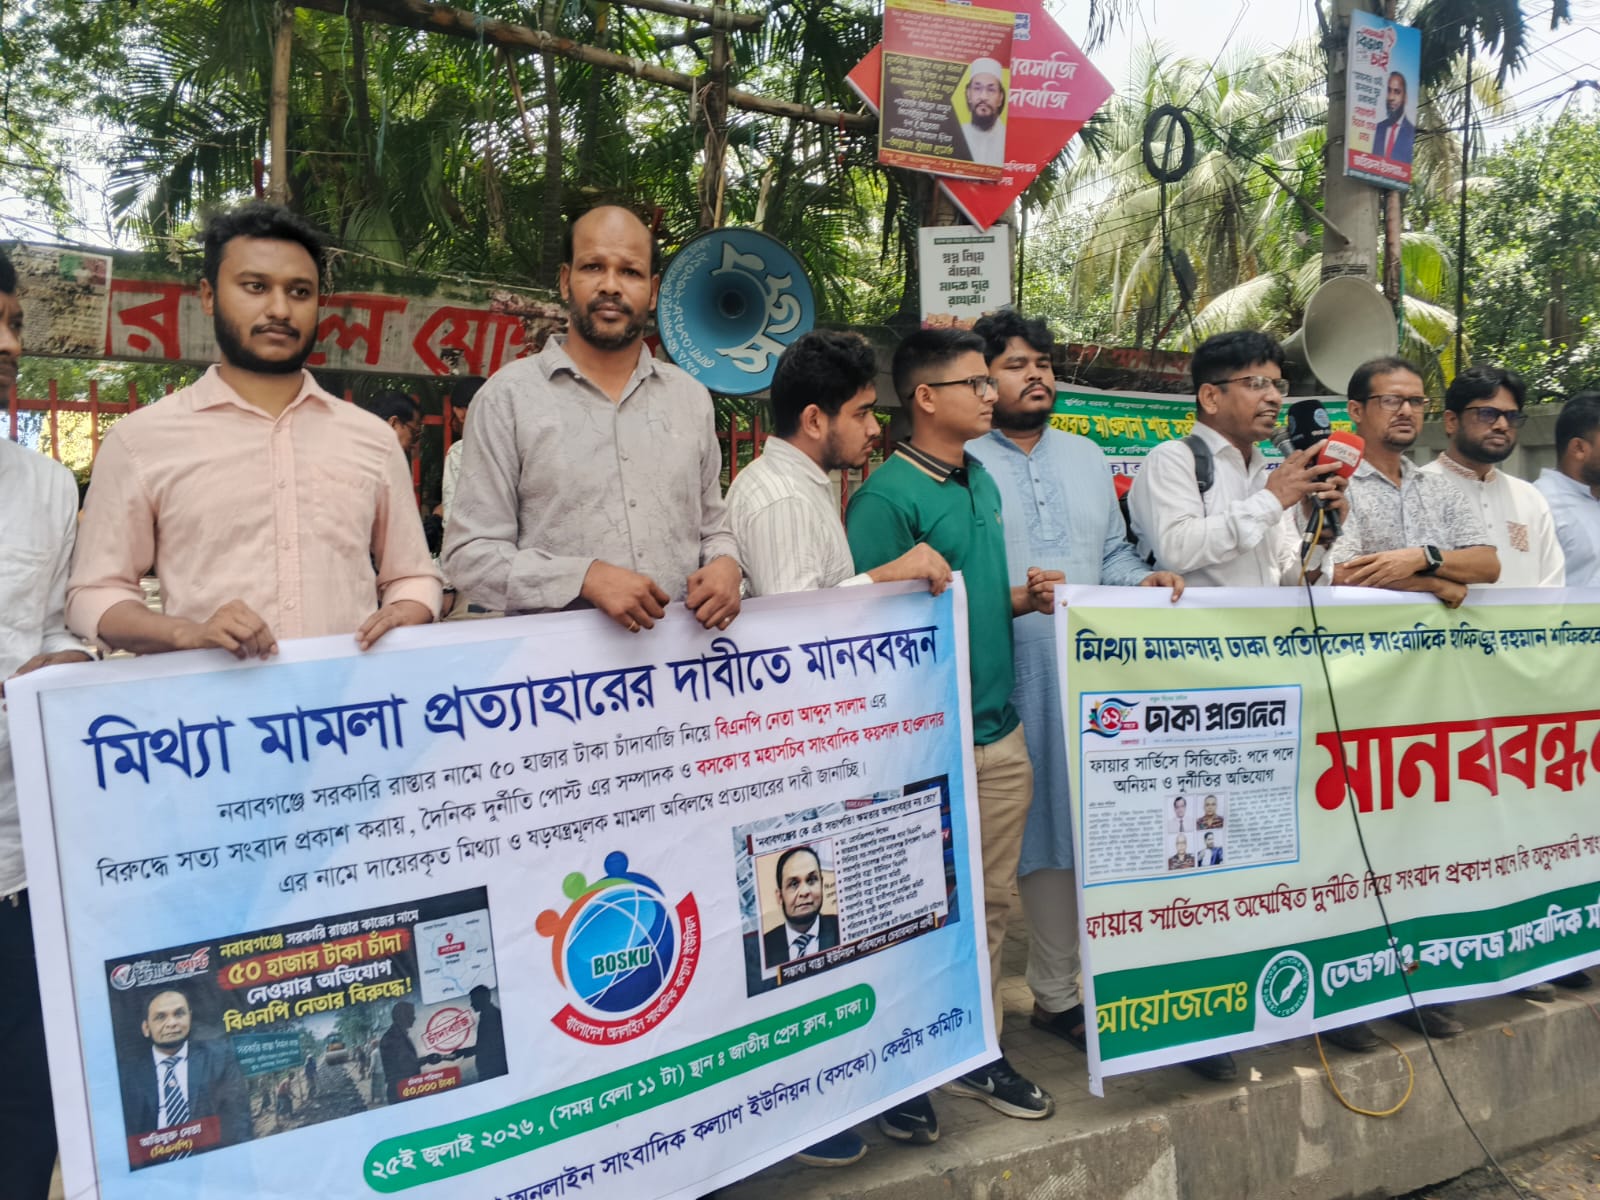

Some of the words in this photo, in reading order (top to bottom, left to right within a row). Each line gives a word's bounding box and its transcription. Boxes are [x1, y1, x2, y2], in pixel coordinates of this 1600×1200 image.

[1010, 51, 1079, 82] ারসাজি
[1007, 81, 1070, 110] দাবাজি
[1075, 628, 1137, 666] মিথ্যা
[1144, 637, 1222, 662] মামলায়
[1225, 636, 1268, 658] ঢাকা
[1273, 626, 1365, 656] প্রতিদিনের
[1369, 622, 1446, 653] সাংবাদিক
[1498, 629, 1546, 650] রহমান
[82, 713, 235, 791] মিথ্যা
[249, 693, 407, 763] মামলা
[425, 664, 657, 740] প্রত্যাহারের
[666, 637, 792, 702] দাবীতে
[799, 625, 939, 682] মানববন্ধন
[1145, 704, 1200, 733] ঢাকা
[1205, 700, 1287, 732] প্রতিদিন
[217, 792, 304, 823] নবাবগঞ্জে
[312, 774, 380, 807] সরকারি
[388, 770, 435, 796] রাস্তার
[442, 762, 482, 787] নামে
[490, 761, 515, 779] ৫০
[521, 748, 568, 773] হাজার
[575, 741, 608, 762] টাকা
[614, 725, 675, 757] চাঁদাবাজি
[680, 723, 711, 746] নিয়ে
[715, 711, 761, 740] বিএনপি
[765, 709, 794, 730] নেতা
[835, 696, 866, 714] সালাম
[870, 693, 887, 709] এর
[1090, 758, 1129, 774] ফায়ার
[1135, 751, 1179, 770] সার্ভিসে
[1247, 750, 1269, 764] পদে
[1273, 747, 1294, 761] পদে
[1114, 775, 1157, 794] অনিয়ম
[1163, 776, 1172, 789] ও
[1226, 768, 1275, 785] অভিযোগ
[1315, 709, 1600, 813] মানববন্ধ
[97, 855, 169, 886] বিরুদ্ধে
[176, 846, 220, 871] সত্য
[228, 835, 288, 863] সংবাদ
[295, 824, 349, 851] প্রকাশ
[420, 800, 476, 830] দৈনিক
[482, 787, 533, 822] দুর্নীতি
[539, 780, 582, 808] পোস্ট
[588, 777, 611, 798] এর
[616, 765, 674, 792] সম্পাদক
[679, 764, 692, 779] ও
[754, 735, 805, 765] মহাসচিব
[807, 727, 861, 754] সাংবাদিক
[279, 872, 308, 894] এর
[314, 863, 358, 888] নামে
[364, 846, 451, 880] দায়েরকৃত
[457, 835, 500, 863] মিথ্যা
[508, 833, 521, 850] ও
[614, 804, 656, 826] মামলা
[661, 787, 713, 819] অবিলম্বে
[718, 776, 784, 807] প্রত্যাহারের
[788, 766, 813, 790] দাবী
[1086, 909, 1143, 939] ফায়ার
[1148, 897, 1230, 930] সার্ভিসের
[1234, 883, 1307, 917] অঘোষিত
[1363, 869, 1391, 898] নিয়ে
[1396, 864, 1440, 890] সংবাদ
[1445, 857, 1493, 884] প্রকাশ
[219, 932, 283, 960] নবাবগঞ্জে
[286, 922, 326, 945] সরকারি
[328, 919, 359, 939] রাস্তার
[361, 912, 396, 931] কাজের
[397, 909, 420, 924] নামে
[227, 961, 262, 985] ৫০
[267, 948, 319, 980] হাজার
[322, 940, 364, 967] টাকা
[367, 930, 402, 957] চাঁদা
[593, 946, 650, 976] BOSKU
[1321, 936, 1415, 997] তেজগাঁও
[1419, 930, 1504, 969] কলেজ
[1507, 904, 1582, 952] সাংবাদিক
[247, 976, 312, 1005] নেওয়ার
[317, 958, 393, 990] অভিযোগ
[223, 1001, 290, 1033] বিএনপি
[294, 993, 345, 1017] নেতার
[371, 1146, 417, 1180] ২৫ই
[421, 1133, 474, 1166] জুলাই
[480, 1119, 545, 1149] ২০২৬,
[599, 1084, 632, 1109] বেলা
[638, 1076, 656, 1097] ১১
[660, 1063, 685, 1089] টা)
[688, 1053, 713, 1078] স্থান
[728, 1032, 770, 1062] জাতীয়
[773, 1024, 799, 1046] প্রেস
[600, 1131, 686, 1175] সাংবাদিক
[691, 1104, 743, 1141] কল্যাণ
[746, 1078, 811, 1117] ইউনিয়ন
[816, 1049, 876, 1094] (বসকো)
